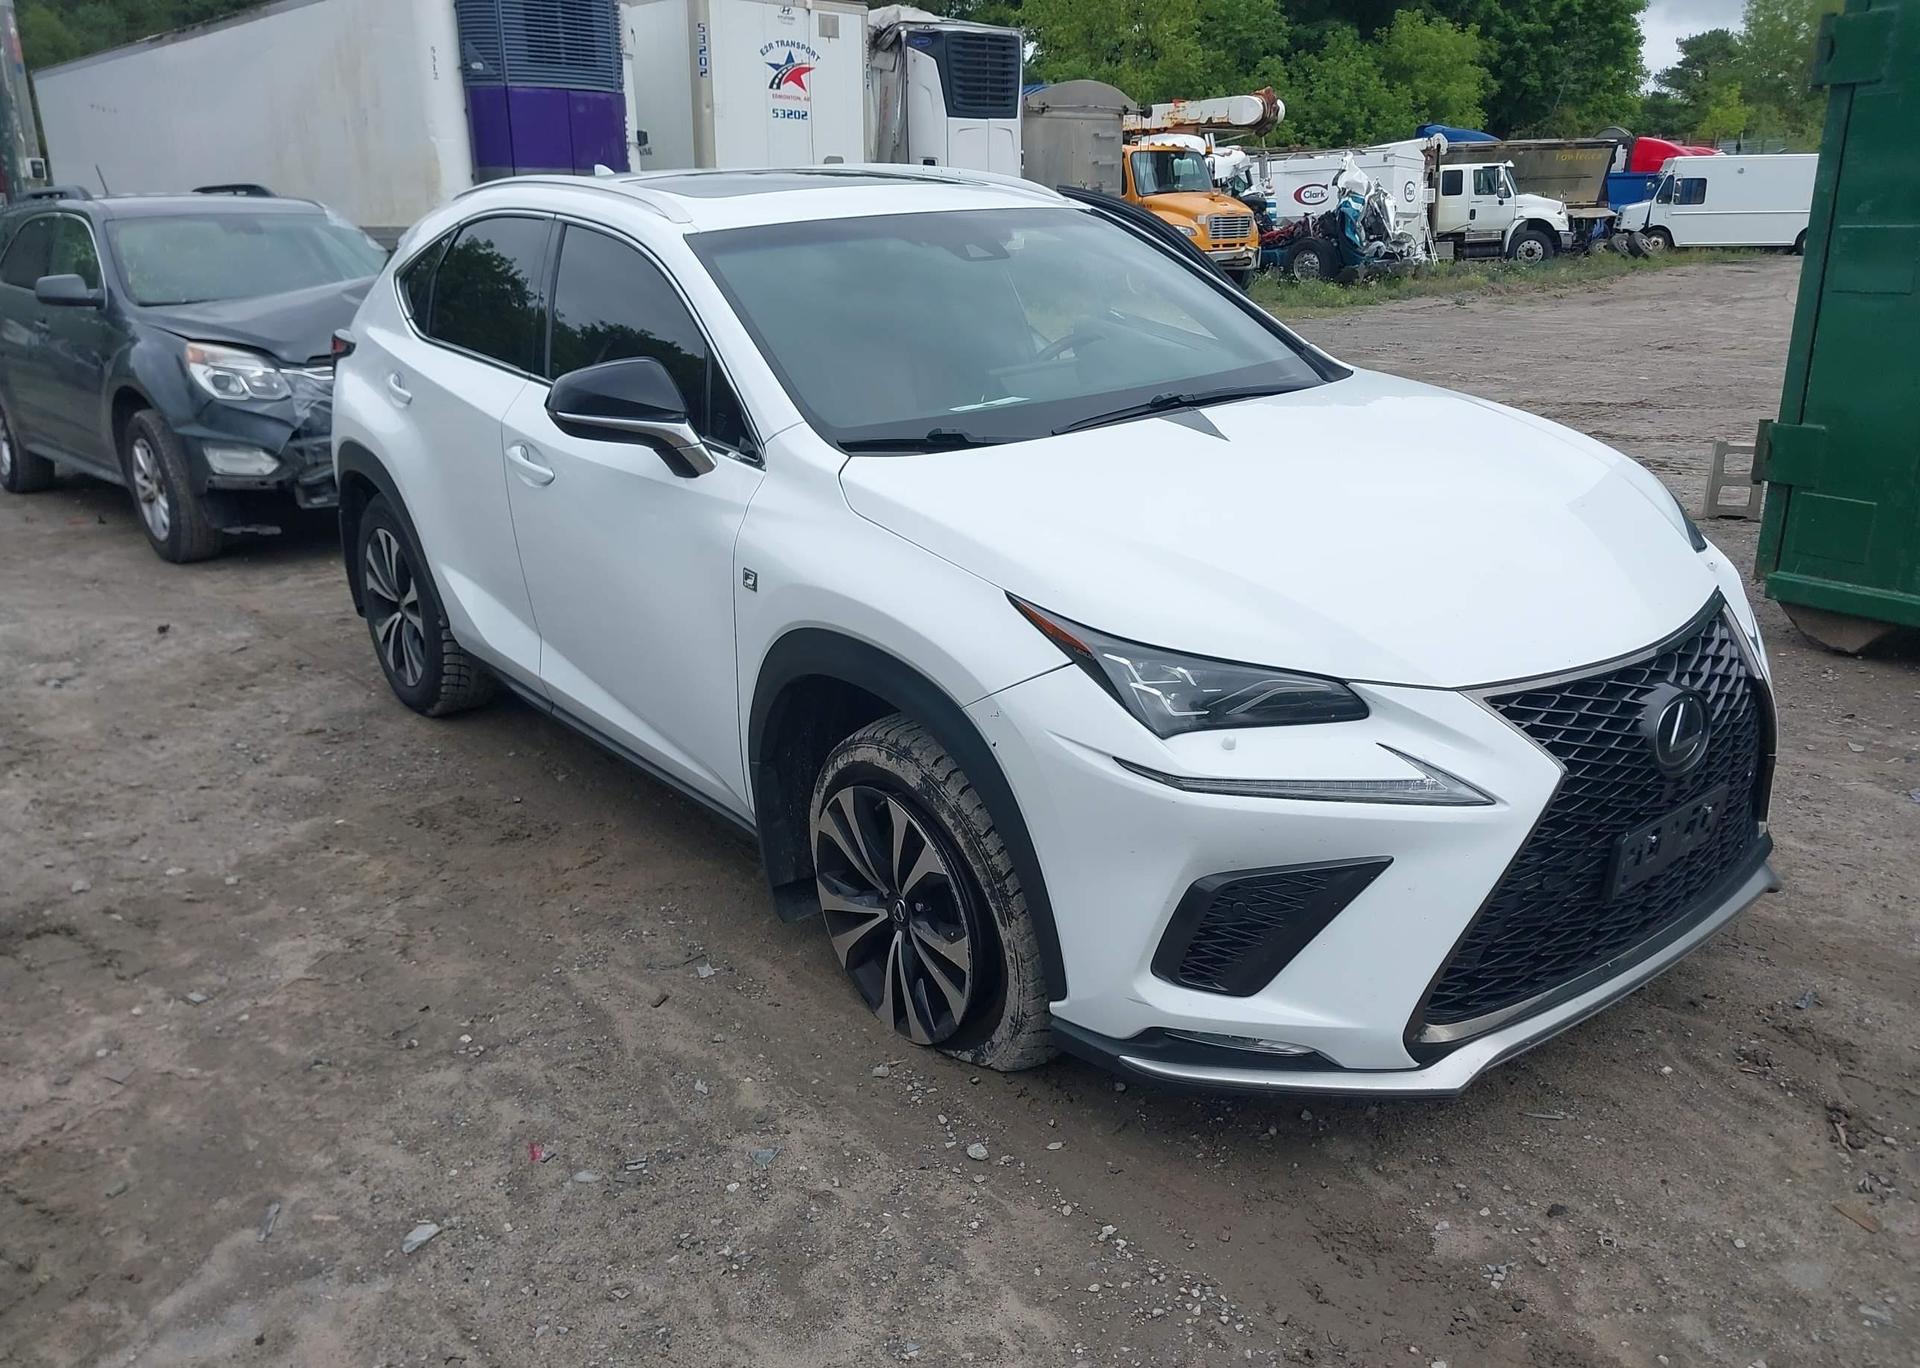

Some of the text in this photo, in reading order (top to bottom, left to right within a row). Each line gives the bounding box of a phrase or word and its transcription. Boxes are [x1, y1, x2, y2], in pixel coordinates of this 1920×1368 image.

[697, 23, 707, 78] 53202
[760, 39, 821, 62] E2R TRANSPORT
[772, 108, 808, 120] 53202
[1303, 190, 1326, 199] Clark
